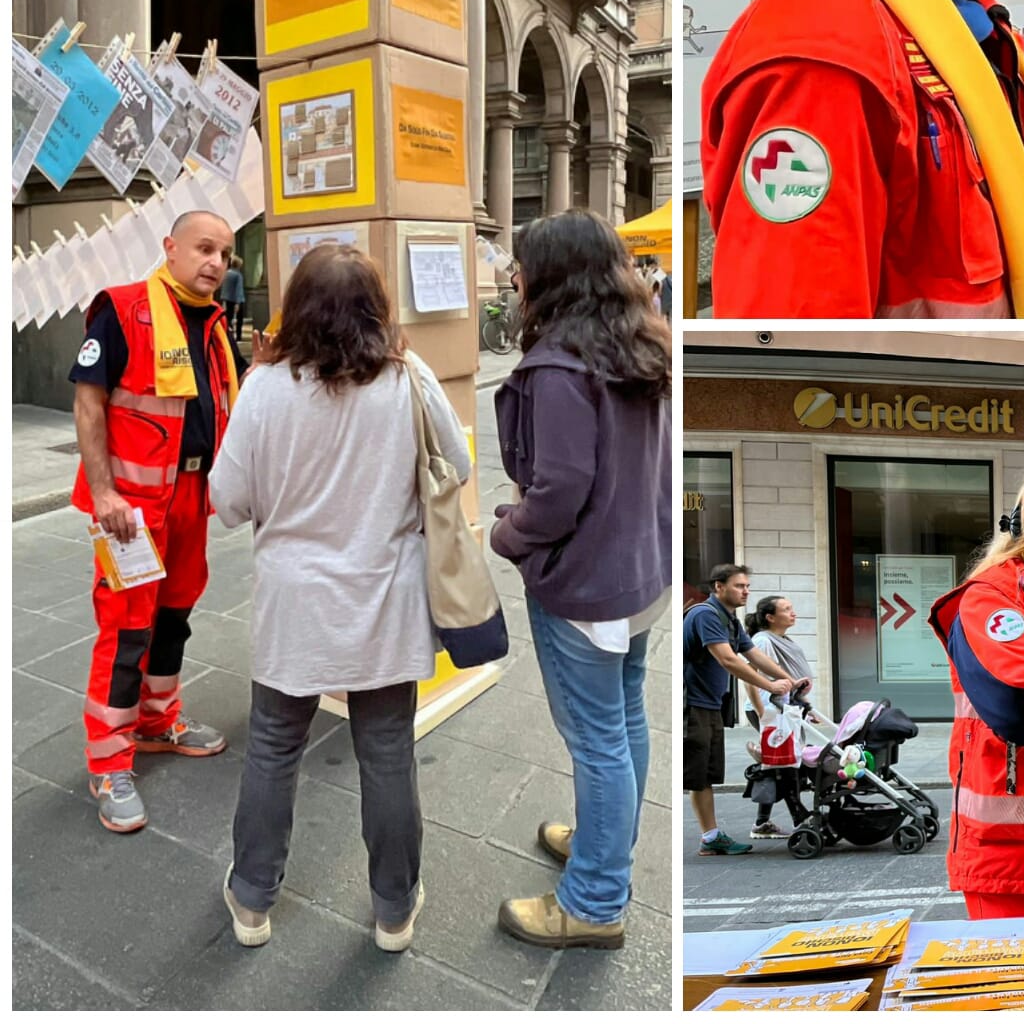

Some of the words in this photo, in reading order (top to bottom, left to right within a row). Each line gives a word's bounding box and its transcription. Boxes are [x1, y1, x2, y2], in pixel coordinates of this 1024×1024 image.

[110, 59, 147, 110] SENZA
[214, 84, 242, 110] 2012
[780, 184, 822, 198] ANPAS
[844, 392, 1014, 433] UniCredit
